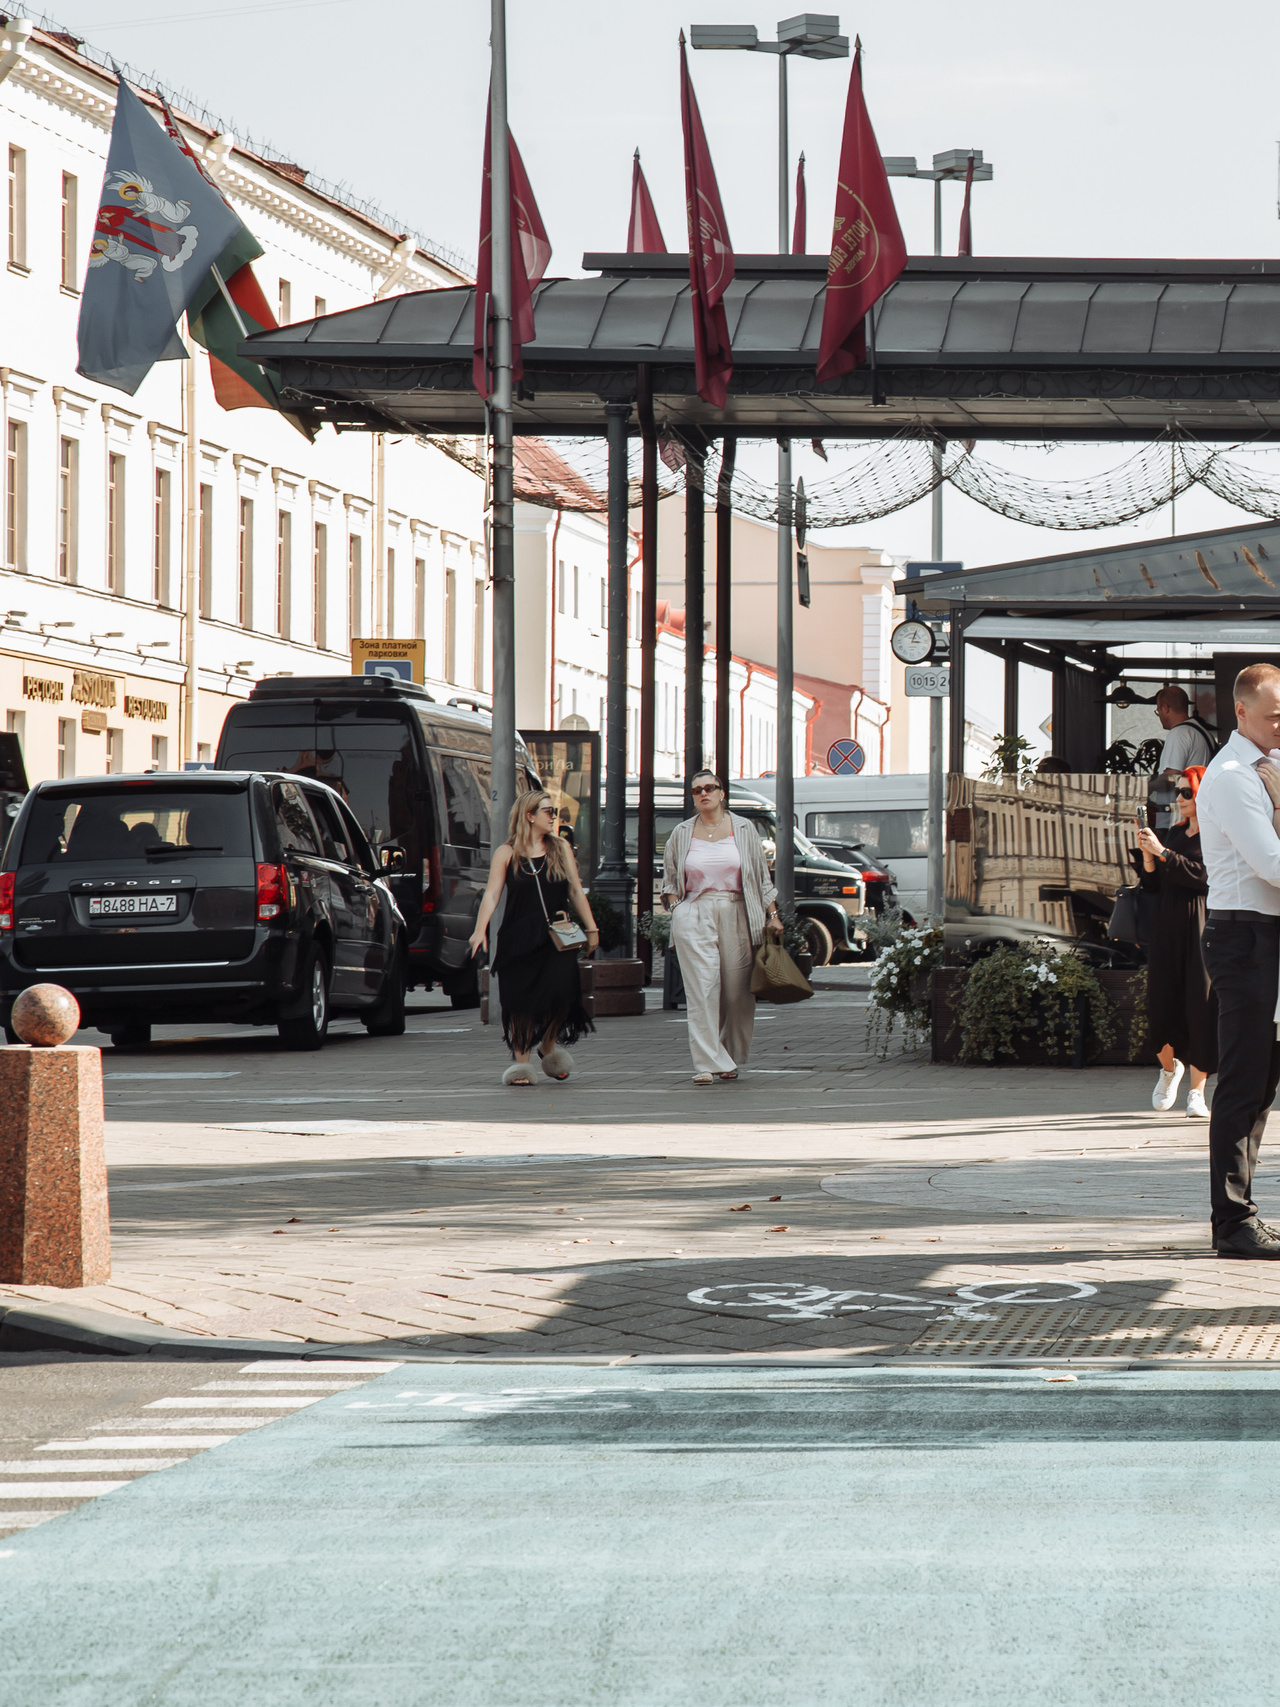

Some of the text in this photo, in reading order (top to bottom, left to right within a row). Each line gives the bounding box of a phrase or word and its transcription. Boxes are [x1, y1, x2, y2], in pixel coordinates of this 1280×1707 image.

[359, 641, 418, 650] Зона платной
[368, 651, 408, 659] парковки
[912, 676, 950, 687] 10 15 2
[25, 676, 64, 701] РЕСТОРАН
[127, 696, 168, 720] RESTAURANT
[492, 790, 498, 801] 2
[103, 897, 174, 912] 8488 HA-7
